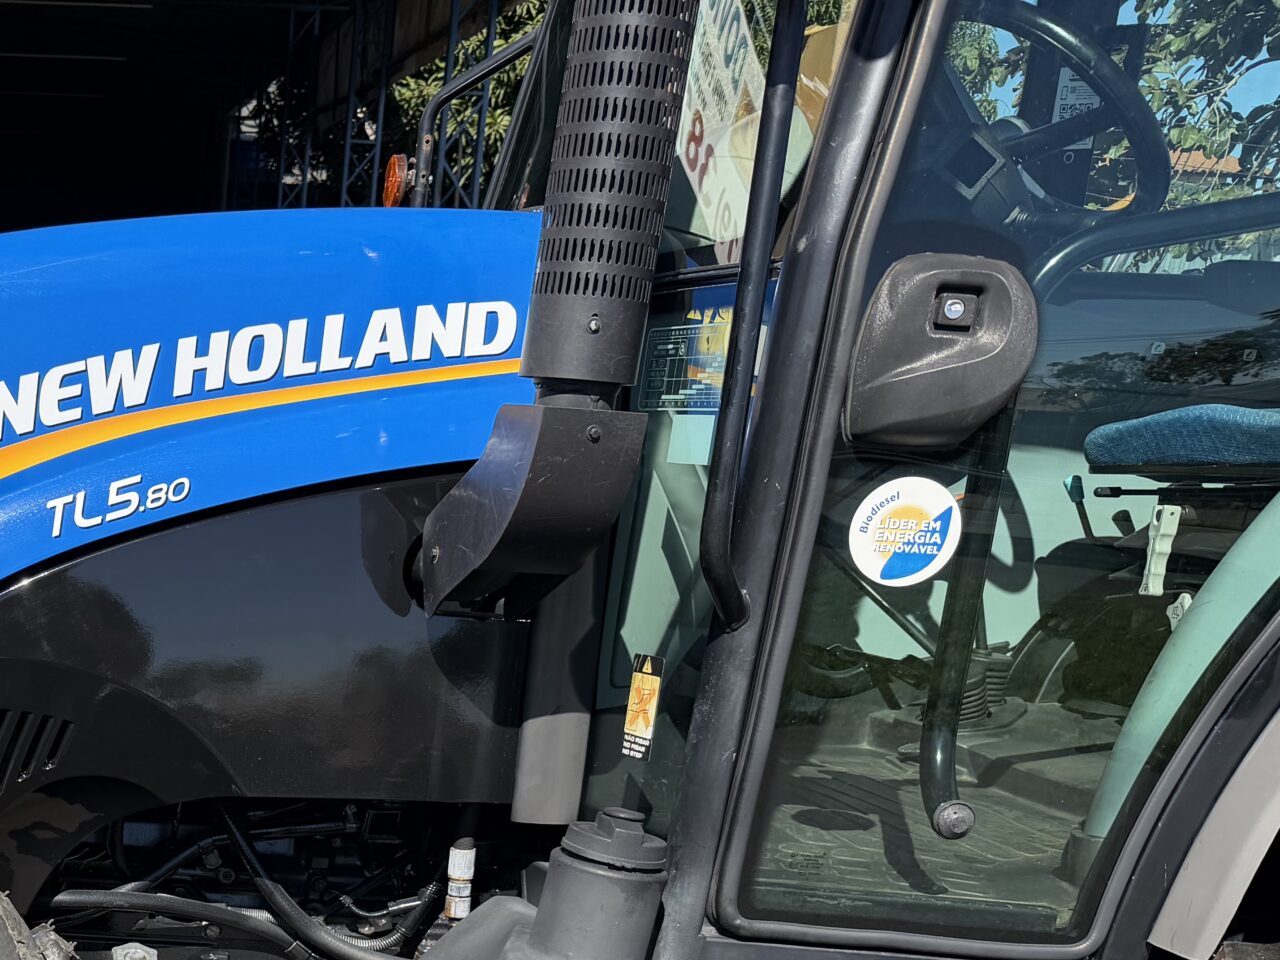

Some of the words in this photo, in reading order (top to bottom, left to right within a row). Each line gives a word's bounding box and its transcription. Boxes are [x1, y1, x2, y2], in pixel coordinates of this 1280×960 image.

[172, 300, 517, 397] HOLLAND
[859, 491, 901, 534] Biodiesel
[876, 517, 919, 531] LÍDER
[921, 520, 942, 531] EM
[875, 531, 942, 544] ENERGIA
